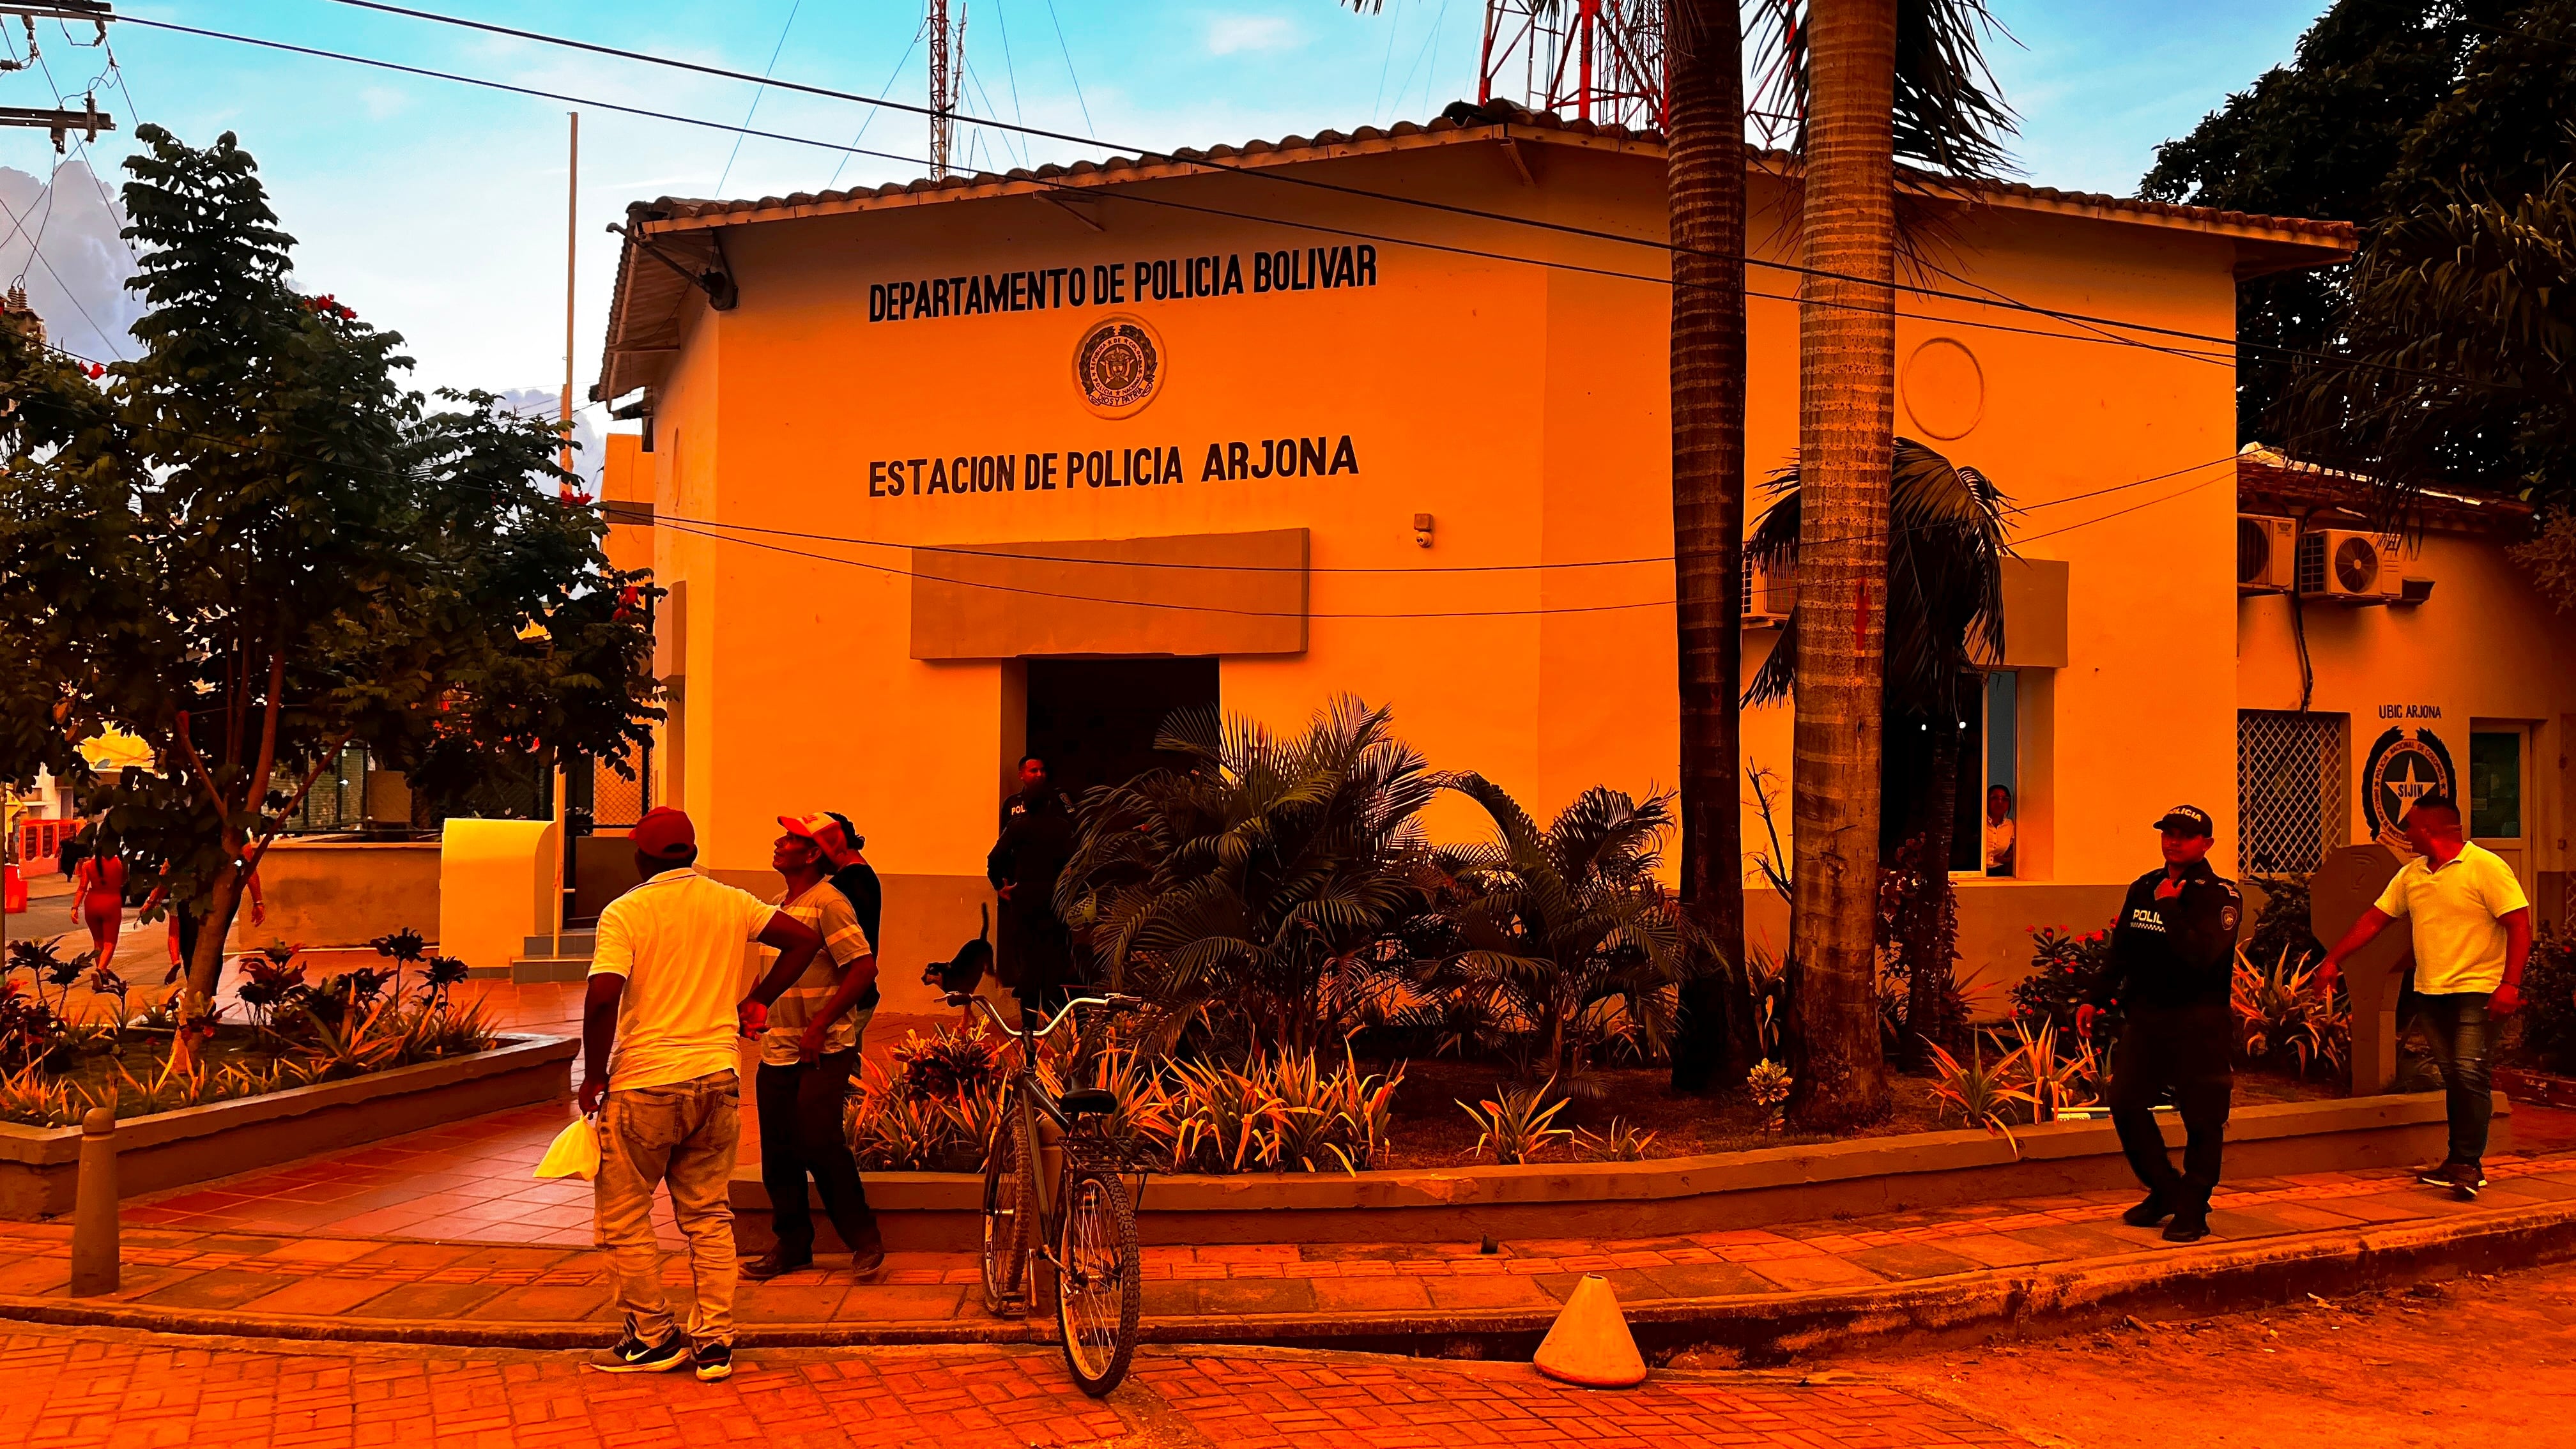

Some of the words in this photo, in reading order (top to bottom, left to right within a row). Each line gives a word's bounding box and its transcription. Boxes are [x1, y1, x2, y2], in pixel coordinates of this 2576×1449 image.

[870, 268, 1086, 323] DEPARTAMENTO
[1093, 263, 1126, 305] DE
[1134, 254, 1245, 302] POLICIA
[1254, 243, 1377, 293] BOLIVAR
[1090, 343, 1107, 371] REPUBLICA
[1093, 378, 1113, 396] POLICIA
[1098, 394, 1114, 406] DIOS
[1114, 397, 1120, 406] Y
[1121, 387, 1144, 404] PATRIA
[869, 454, 1016, 498] ESTACION
[1024, 452, 1058, 491] DE
[1066, 445, 1184, 489] POLICIA
[1200, 434, 1360, 483] ARJONA
[2379, 704, 2403, 719] UBIC
[2405, 704, 2442, 719] ARJONA
[2398, 784, 2424, 799] SIJIN
